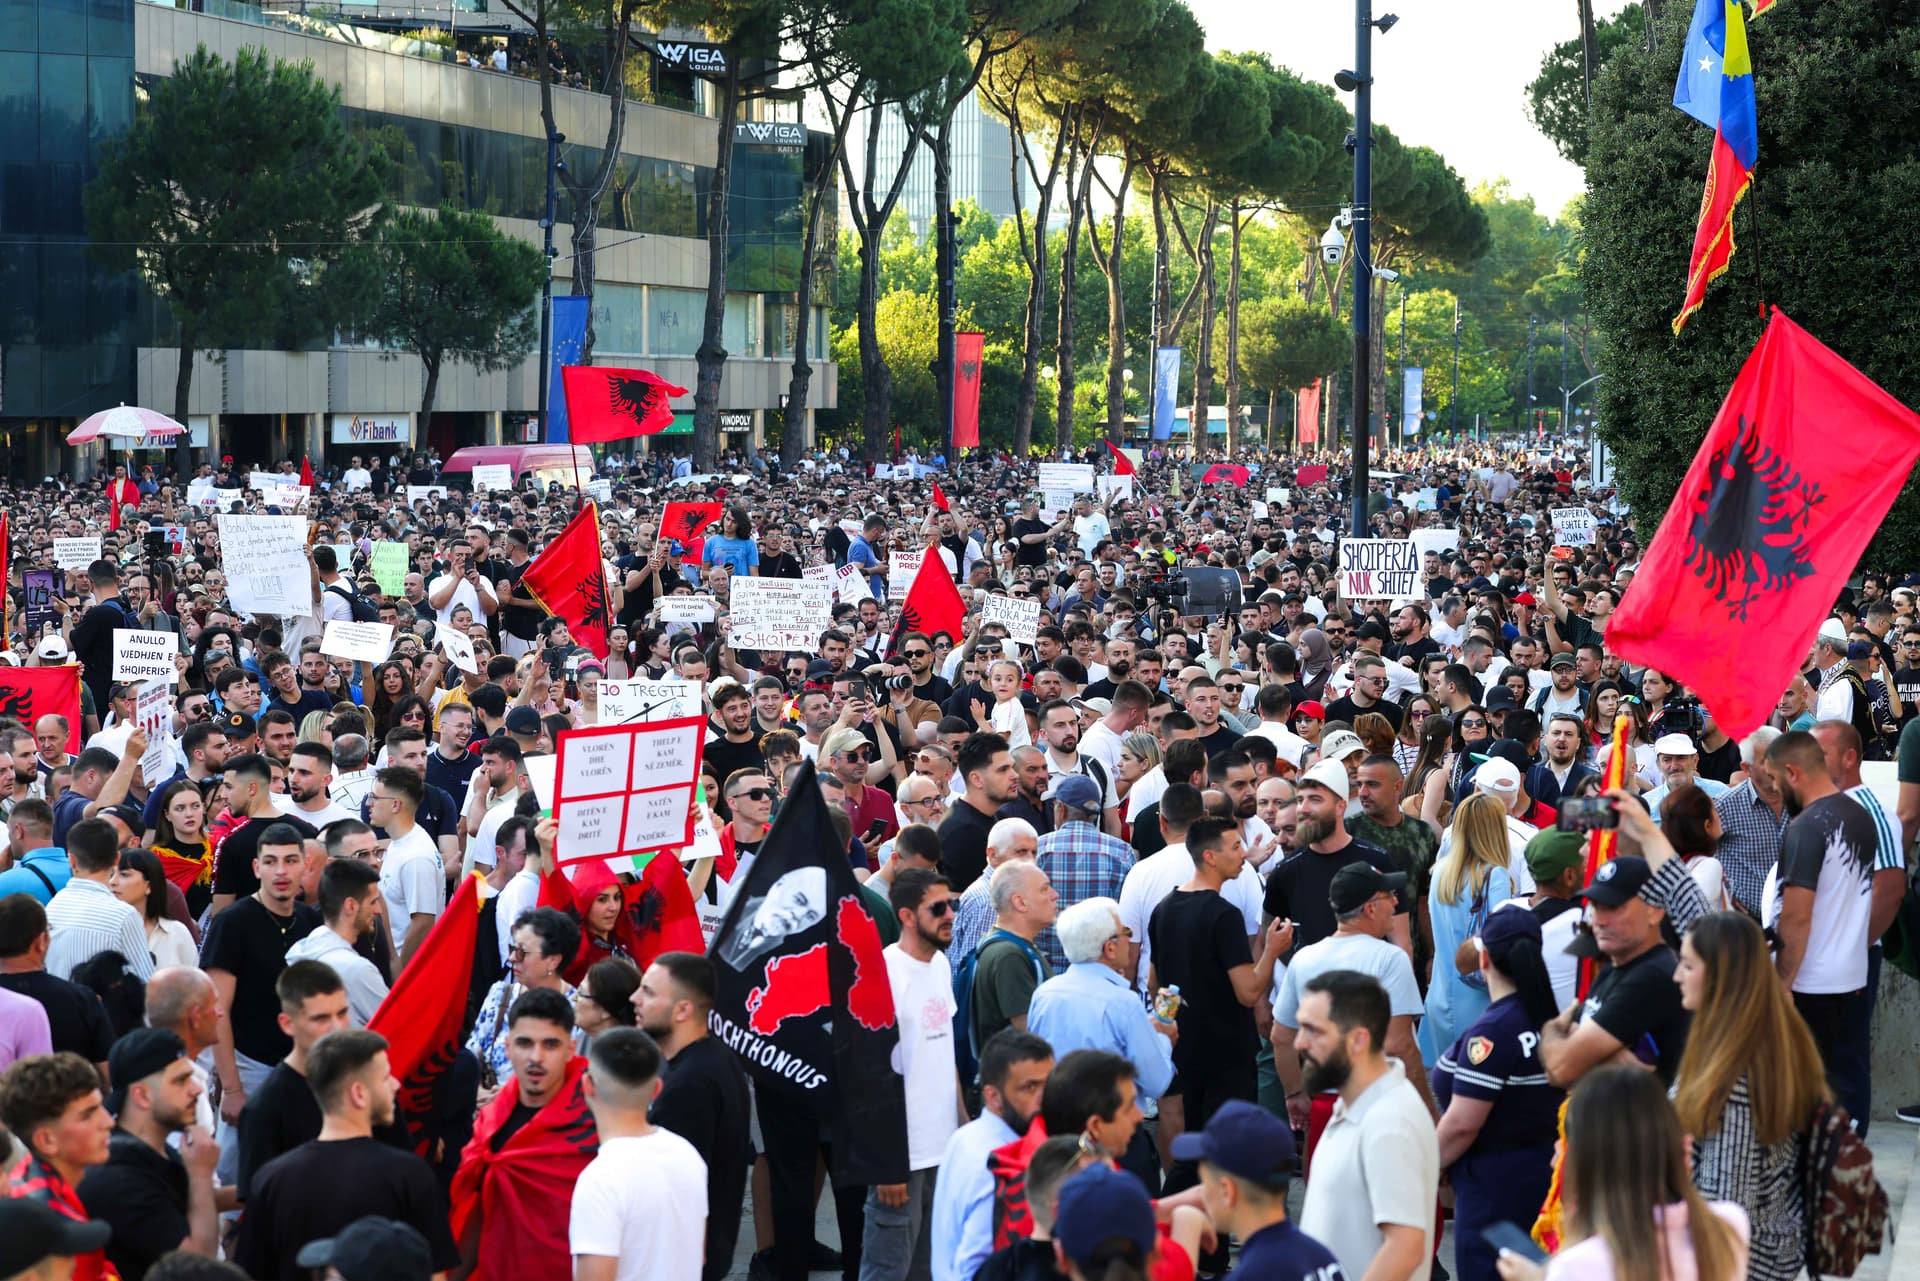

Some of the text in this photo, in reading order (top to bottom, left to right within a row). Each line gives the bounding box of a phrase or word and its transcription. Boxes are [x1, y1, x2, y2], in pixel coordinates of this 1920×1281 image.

[721, 414, 751, 426] VINOPOLY
[363, 420, 397, 440] Fibank
[1584, 520, 1589, 528] E
[1563, 532, 1586, 543] JONA
[895, 553, 914, 561] MOS
[1343, 540, 1419, 571] SHQIPËRIA
[1349, 570, 1417, 595] NUK SHITET
[1011, 599, 1037, 613] PYLLI
[984, 606, 990, 617] &
[993, 607, 1019, 621] TOKA
[129, 635, 166, 646] ANULLO
[120, 650, 174, 661] VJEDHJEN E
[601, 683, 688, 698] JO TREGTI
[604, 704, 625, 717] ME
[656, 748, 675, 758] KAM
[653, 808, 671, 818] KAM
[581, 818, 600, 828] KAM
